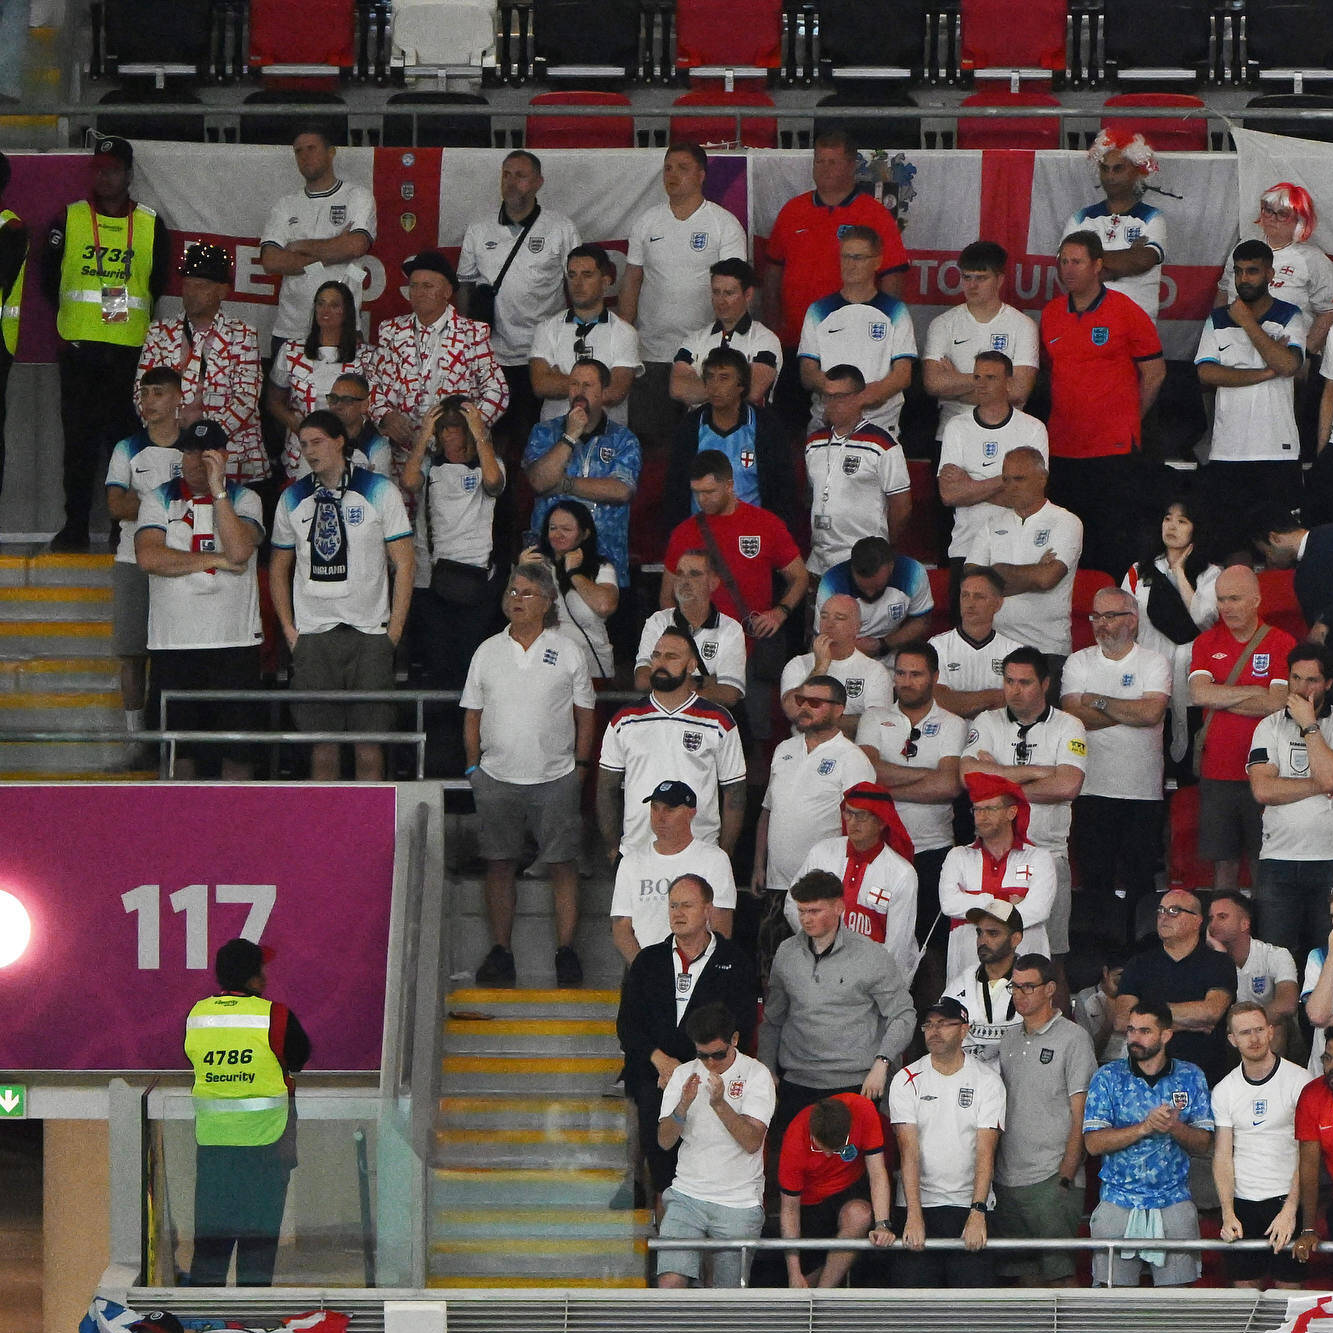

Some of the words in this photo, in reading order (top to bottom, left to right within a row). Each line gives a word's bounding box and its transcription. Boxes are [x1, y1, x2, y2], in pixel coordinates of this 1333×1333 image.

[639, 879, 669, 896] BO
[121, 885, 277, 969] 117
[203, 1049, 252, 1066] 4786
[204, 1072, 255, 1084] Security
